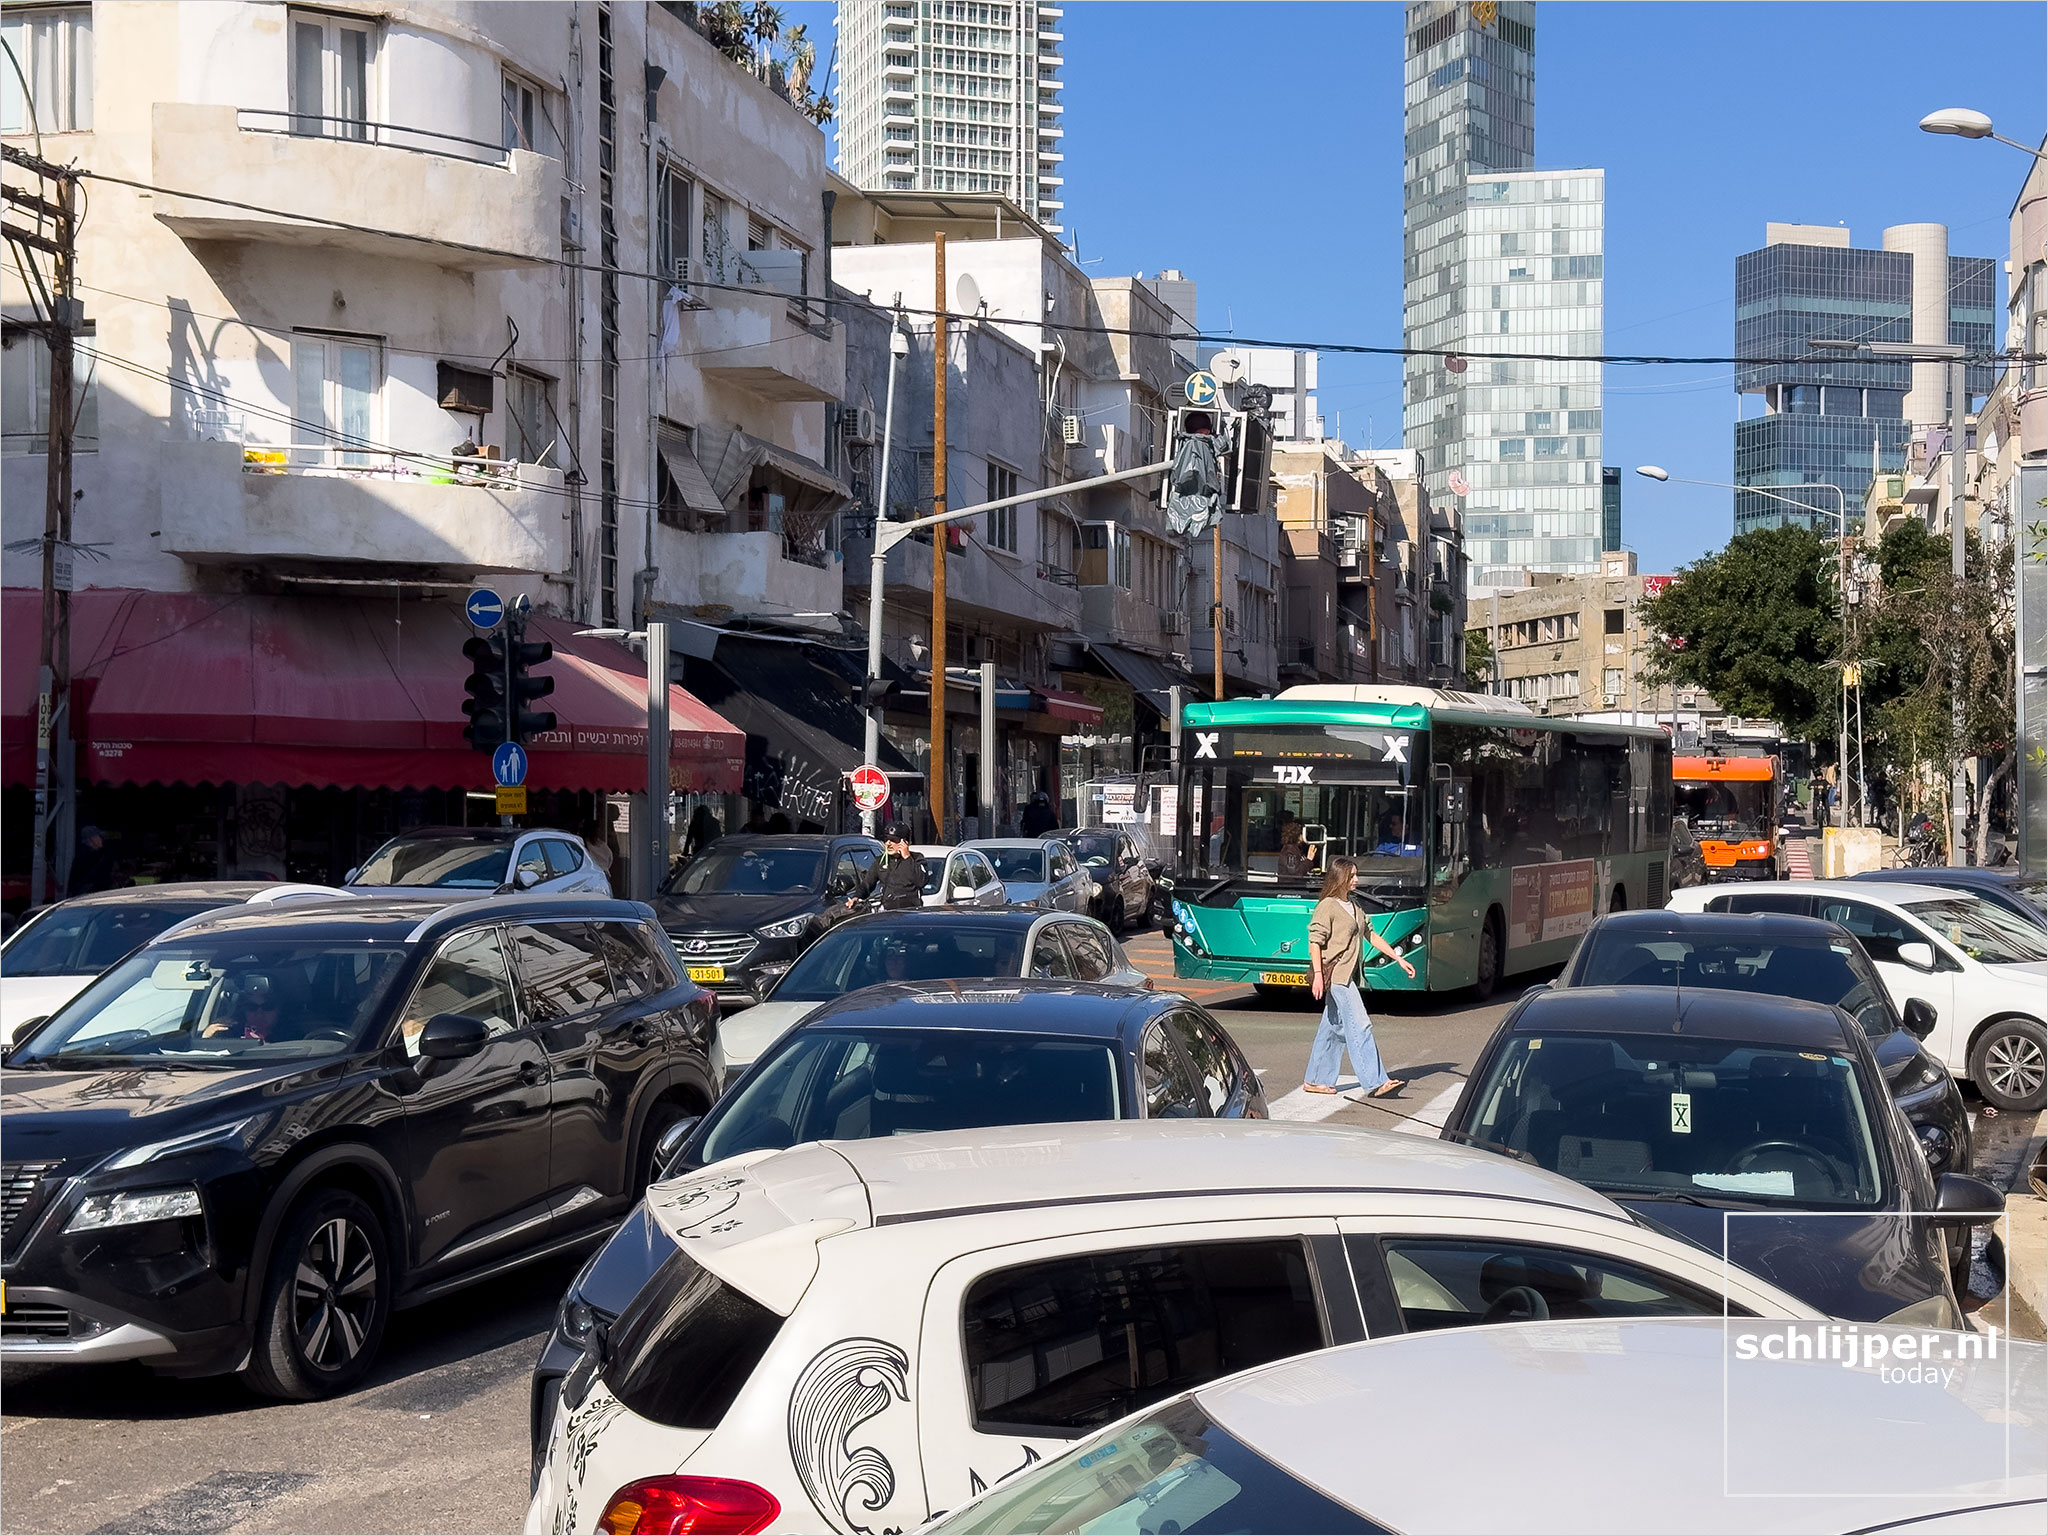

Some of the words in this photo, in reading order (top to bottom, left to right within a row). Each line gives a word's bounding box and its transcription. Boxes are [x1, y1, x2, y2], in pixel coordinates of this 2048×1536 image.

[532, 731, 572, 743] ותבלינ
[578, 732, 609, 744] יבשים
[613, 732, 644, 746] לפירות
[1673, 1107, 1689, 1127] X
